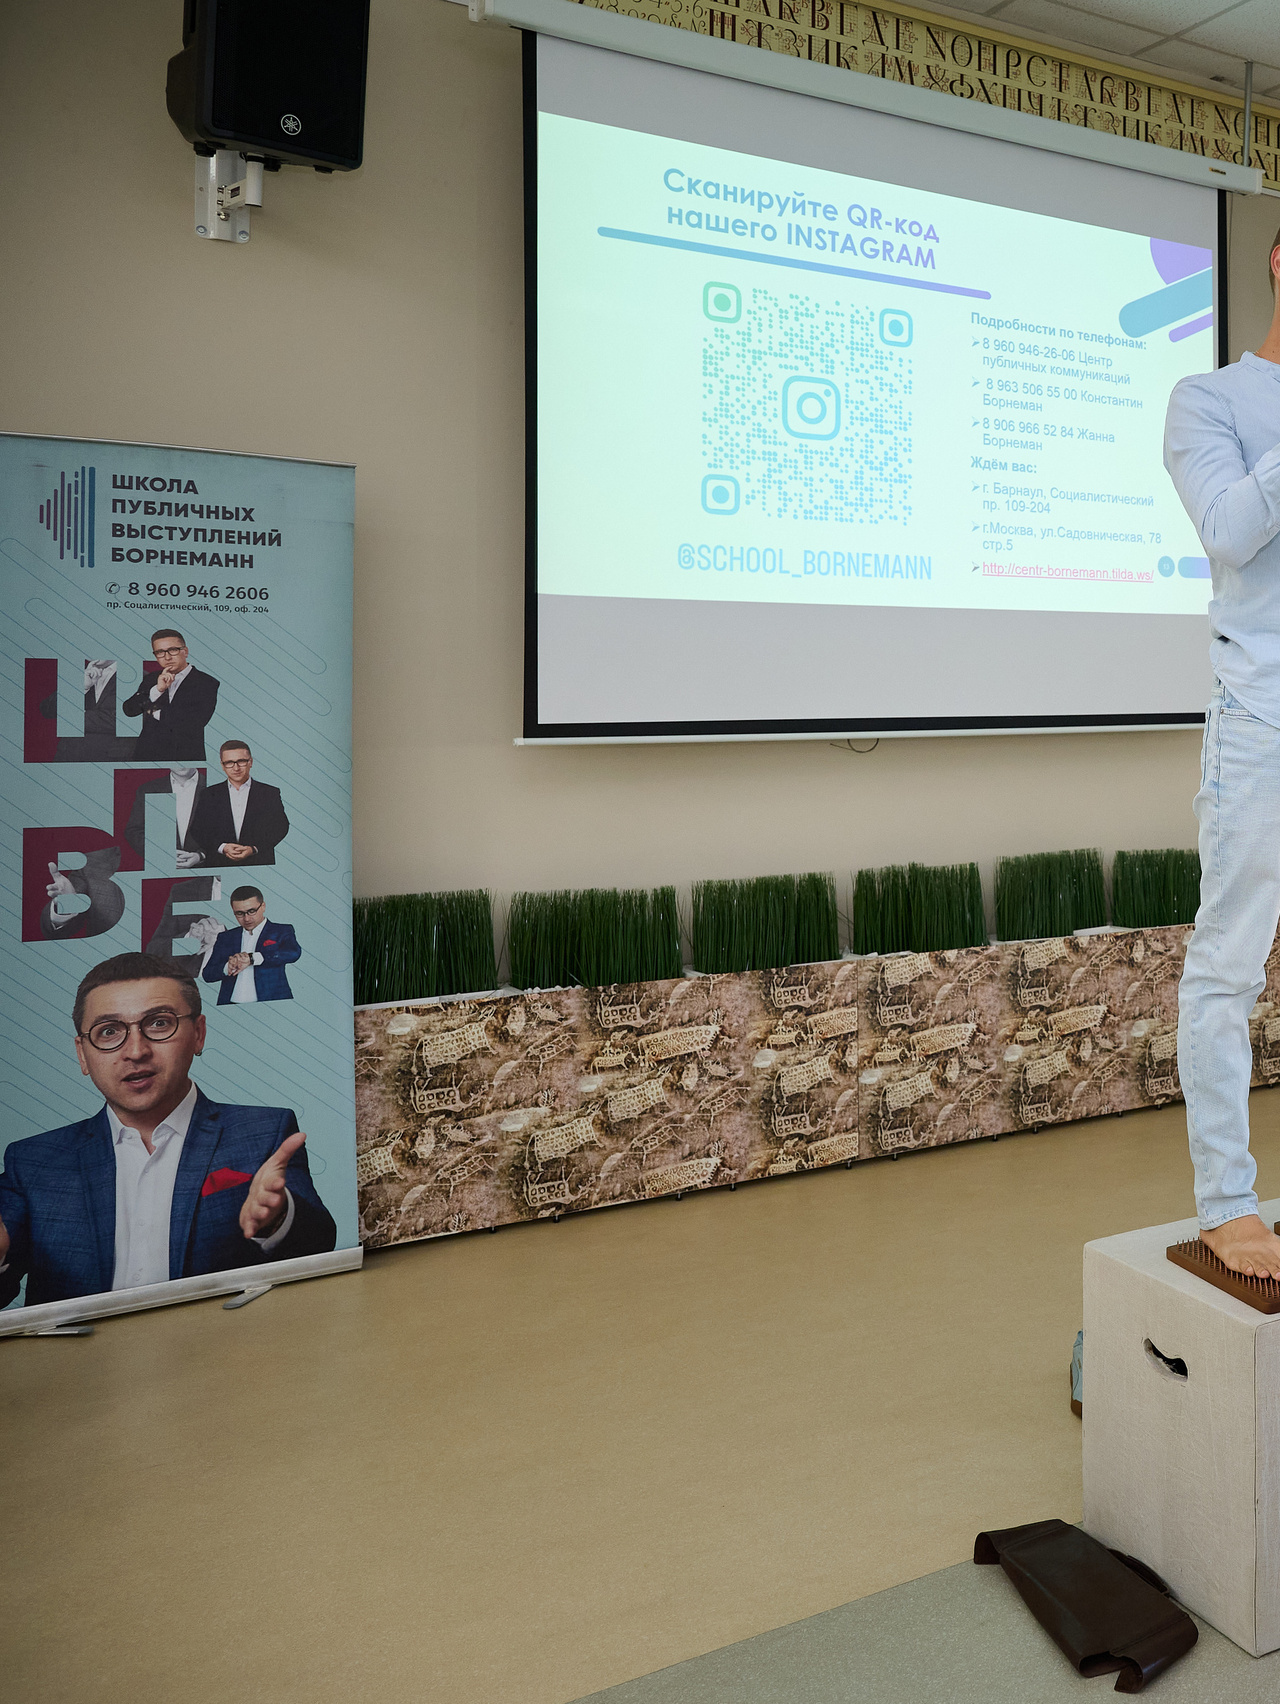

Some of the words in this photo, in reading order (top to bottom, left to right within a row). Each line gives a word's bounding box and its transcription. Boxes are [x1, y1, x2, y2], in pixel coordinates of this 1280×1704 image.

[663, 168, 839, 222] Сканируйте
[847, 203, 940, 243] QR-код
[667, 206, 777, 242] нашего
[786, 222, 937, 270] INSTAGRAM
[971, 311, 1056, 336] Подробности
[1059, 327, 1075, 340] по
[1077, 330, 1147, 350] телефонам:
[982, 337, 990, 350] 8
[993, 338, 1015, 353] 960
[1018, 342, 1076, 362] 946-26-06
[1078, 352, 1113, 370] Центр
[982, 354, 1047, 374] публичных
[1050, 366, 1131, 386] коммуникаций
[983, 393, 1043, 412] Борнеман
[986, 378, 994, 390] 8
[997, 379, 1019, 393] 963
[1022, 382, 1044, 396] 506
[1046, 385, 1060, 398] 55
[1064, 387, 1078, 400] 00
[1080, 390, 1143, 409] Константин
[982, 417, 990, 430] 8
[993, 418, 1015, 432] 906
[1018, 420, 1040, 435] 966
[1043, 424, 1057, 437] 52
[1060, 426, 1074, 438] 84
[1077, 428, 1116, 443] Жанна
[983, 434, 1043, 451] Борнеман
[970, 456, 1008, 472] Ждём
[1012, 460, 1038, 474] вас:
[112, 474, 199, 494] ШКОЛА
[982, 484, 989, 494] г.
[993, 482, 1047, 500] Барнаул,
[1050, 486, 1154, 506] Социалистический
[112, 498, 256, 522] ПУБЛИЧНЫХ
[982, 500, 1000, 512] пр.
[1005, 499, 1051, 514] 109-204
[112, 522, 282, 547] ВЫСТУПЛЕНИЙ
[982, 538, 1014, 553] стр.5
[1149, 532, 1162, 544] 78
[111, 547, 254, 569] БОРНЕМАНН
[678, 542, 932, 580] @SCHOOL_BORNEMANN
[982, 562, 1154, 582] http://centr-bornemann.tilda.ws/
[128, 582, 140, 596] 8
[146, 582, 180, 597] 960
[186, 584, 220, 598] 946
[225, 586, 270, 600] 2606
[106, 602, 122, 610] пр.
[124, 601, 212, 612] Соцалистический,
[215, 604, 232, 614] 109,
[234, 604, 250, 614] оф.
[252, 606, 269, 614] 204
